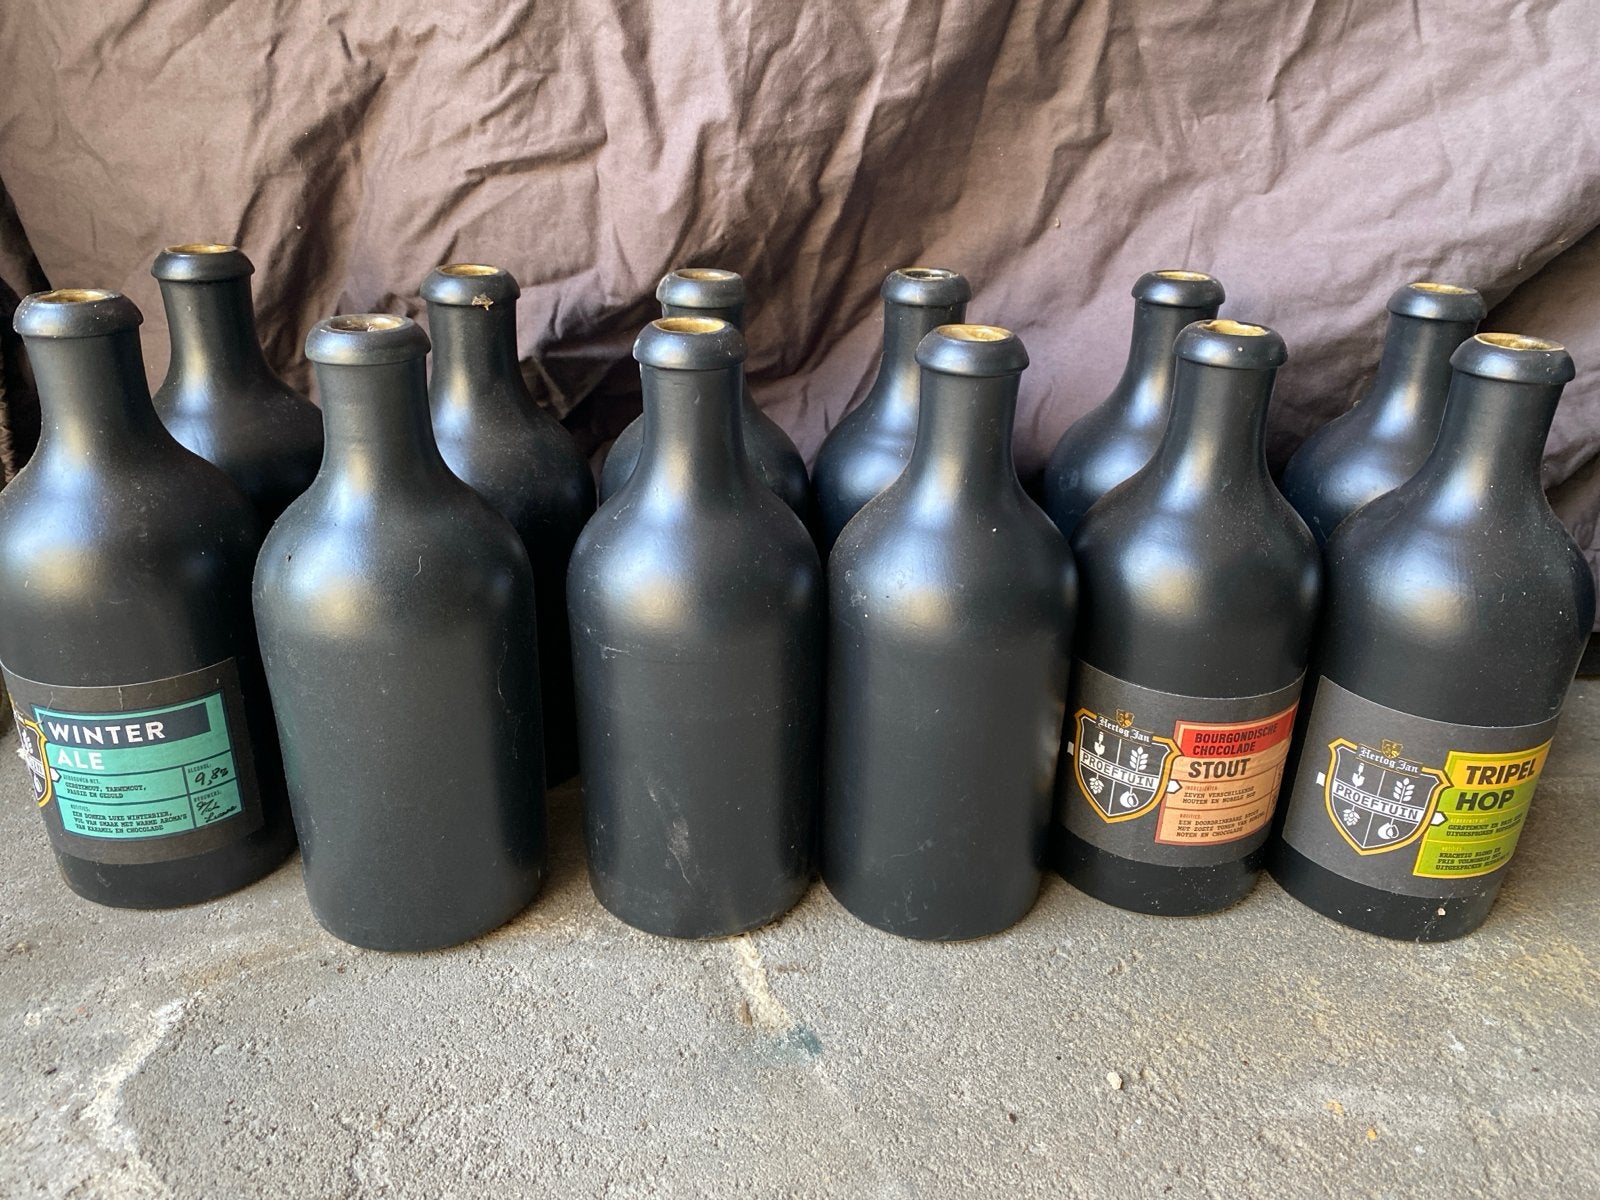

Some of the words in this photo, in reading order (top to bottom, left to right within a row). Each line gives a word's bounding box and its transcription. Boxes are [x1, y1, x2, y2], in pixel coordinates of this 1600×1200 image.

[47, 721, 166, 744] WINTER
[1098, 717, 1130, 738] Hertog
[1130, 728, 1150, 743] Jan
[1194, 722, 1278, 744] BOURGONDISCHE
[57, 748, 105, 770] ALE
[1192, 742, 1256, 756] CHOCOLADE
[1082, 754, 1154, 788] PROEFTUIN
[1188, 758, 1251, 779] STOUT
[1358, 747, 1396, 768] Hertog
[1396, 759, 1418, 774] Jan
[1466, 758, 1536, 785] TRIPEL
[106, 784, 146, 792] TARWEMOUT,
[1335, 784, 1418, 820] PROEFTUIN
[1456, 789, 1515, 811] HOP
[84, 813, 107, 821] DONKER
[126, 812, 172, 820] WINTERBIER,
[160, 814, 188, 824] AROMA'S
[126, 826, 164, 834] CHOCOLADE
